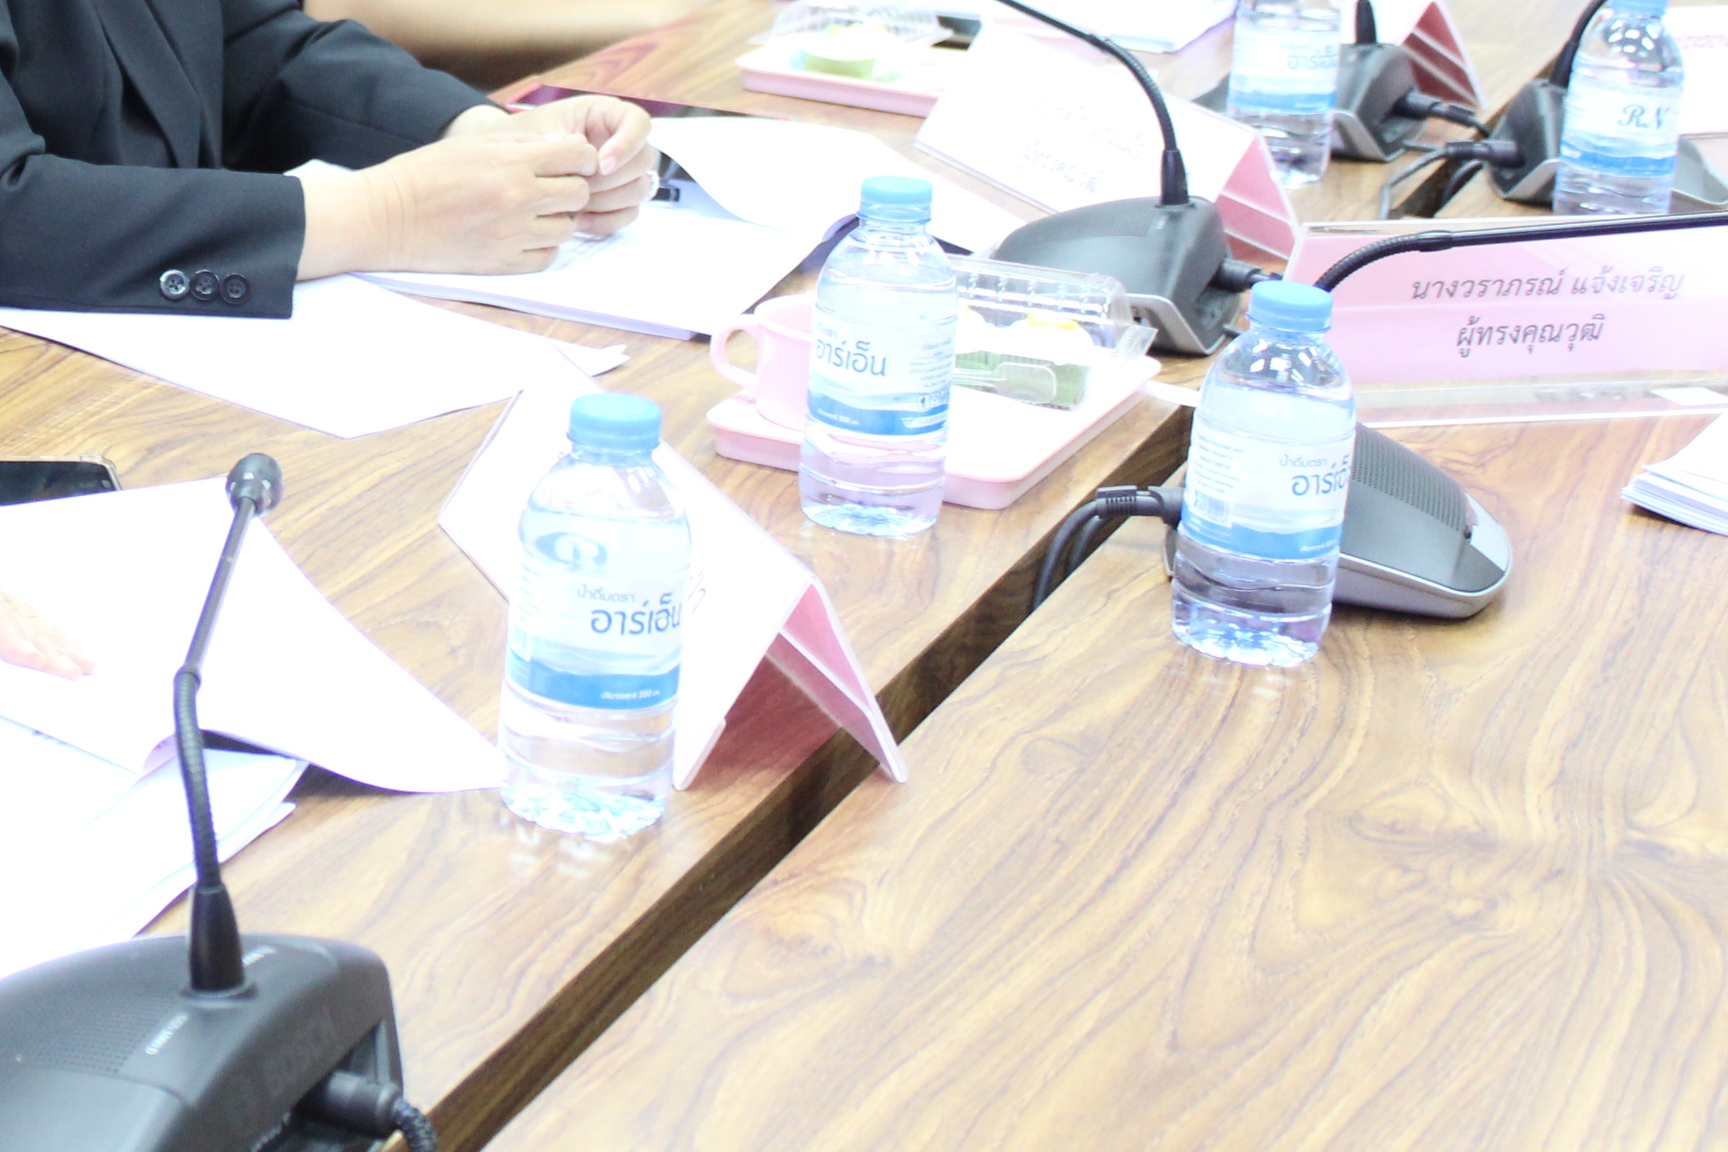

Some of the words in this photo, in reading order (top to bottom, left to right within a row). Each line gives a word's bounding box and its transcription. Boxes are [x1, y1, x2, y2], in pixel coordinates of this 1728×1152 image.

[1617, 104, 1671, 130] RN
[1410, 266, 1569, 301] นางวราภรณ์
[1571, 264, 1686, 301] แจ้งเจริญ
[1455, 314, 1606, 358] ผู้ทรงคุณวุฒิ
[815, 338, 887, 377] อาร์เอ็น
[1291, 454, 1350, 497] อาร์เอ็
[576, 583, 636, 603] น้ำดื่มตรา
[590, 591, 683, 636] อาร์เอ็น
